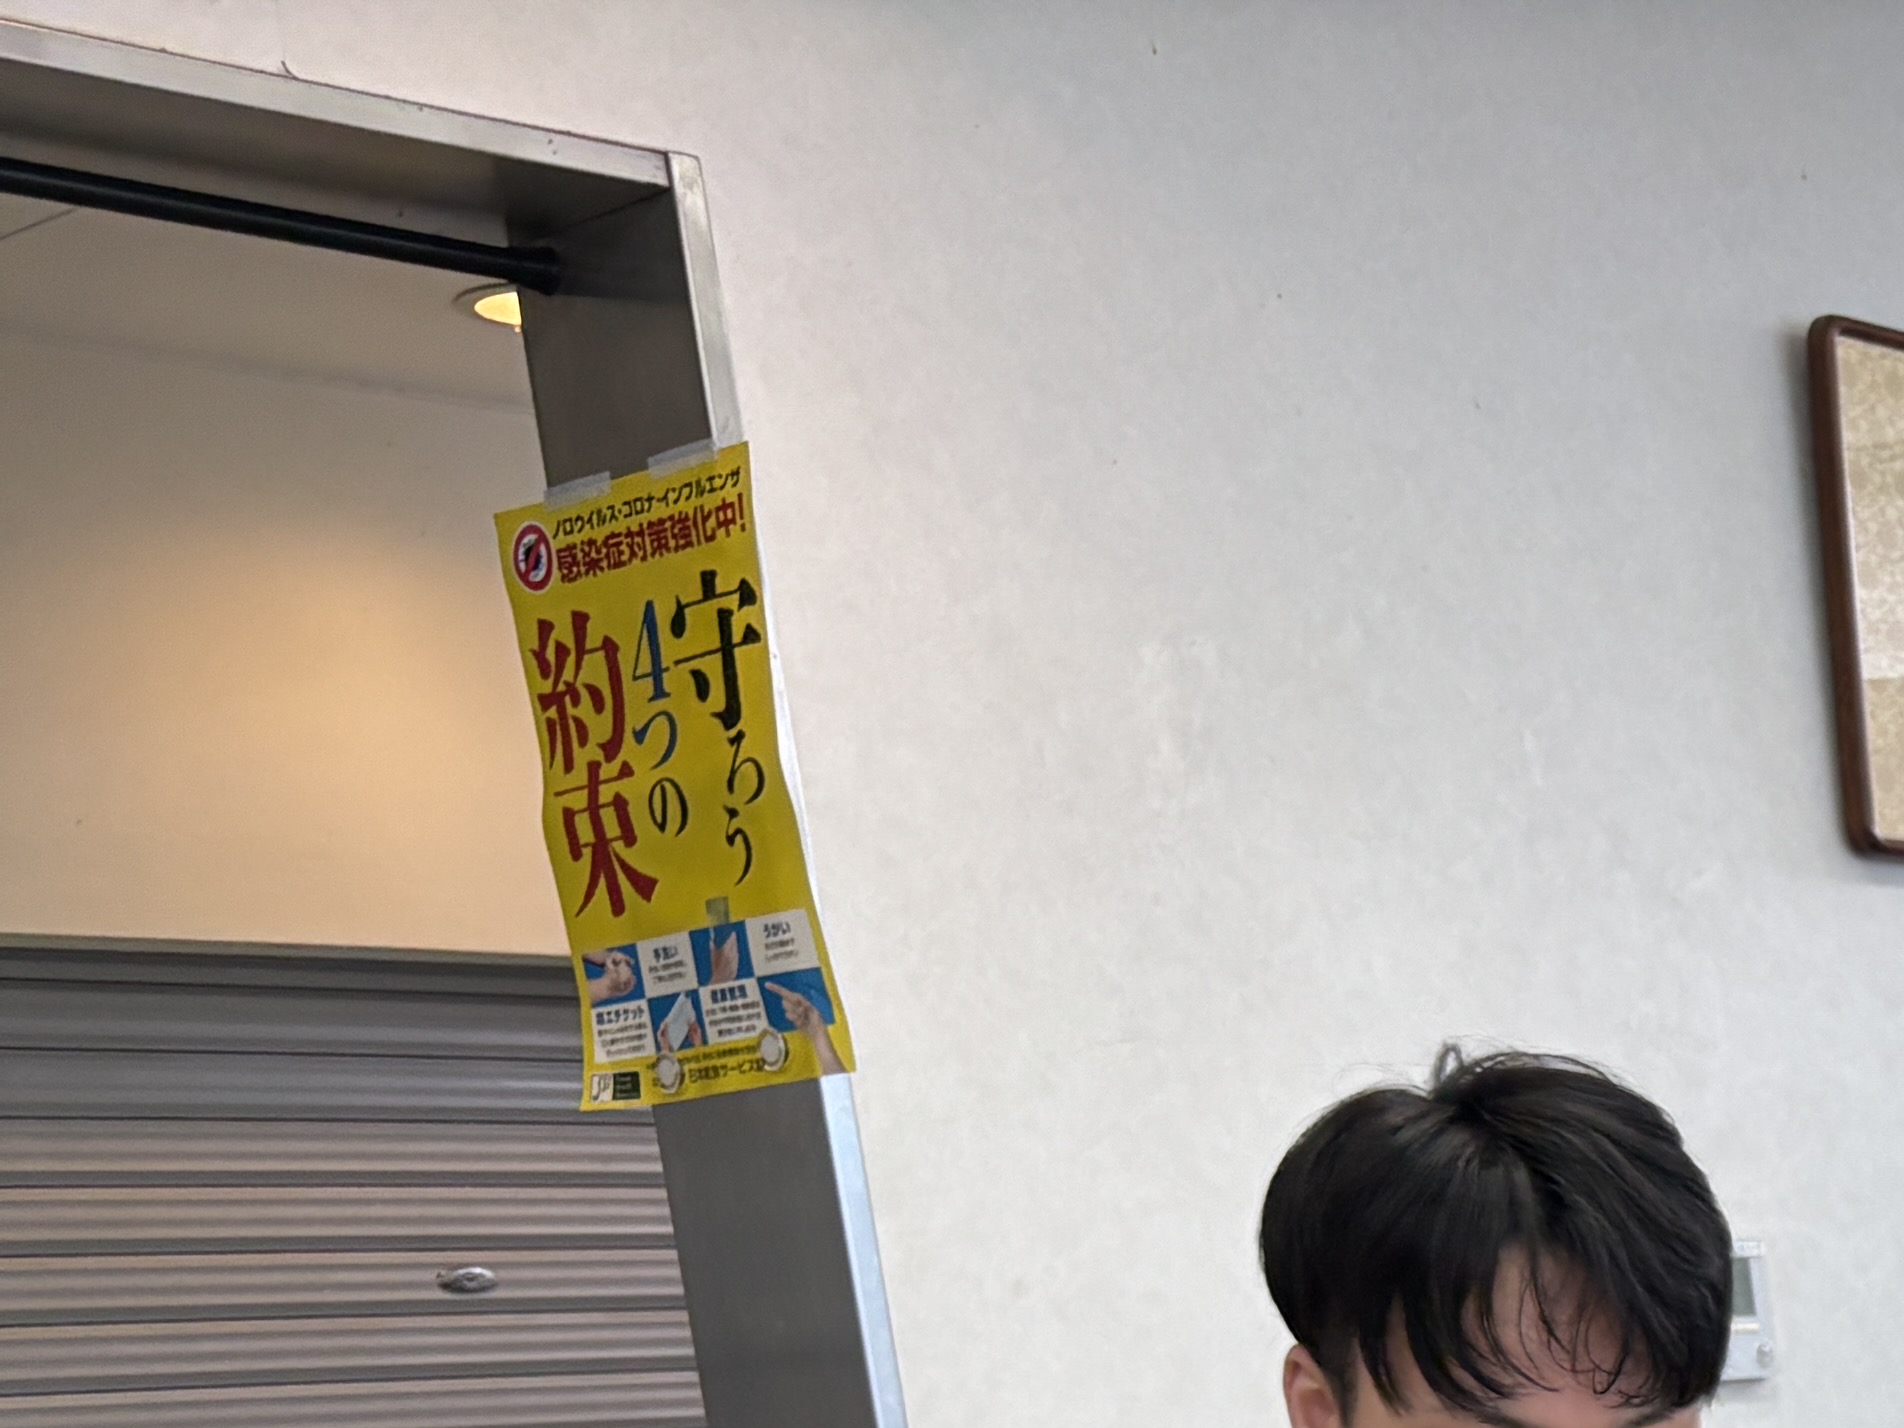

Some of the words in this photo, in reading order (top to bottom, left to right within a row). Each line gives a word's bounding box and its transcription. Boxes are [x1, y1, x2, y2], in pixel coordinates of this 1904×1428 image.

[529, 610, 659, 918] 約束
[632, 599, 689, 838] 4つの
[669, 569, 766, 887] 守ろう
